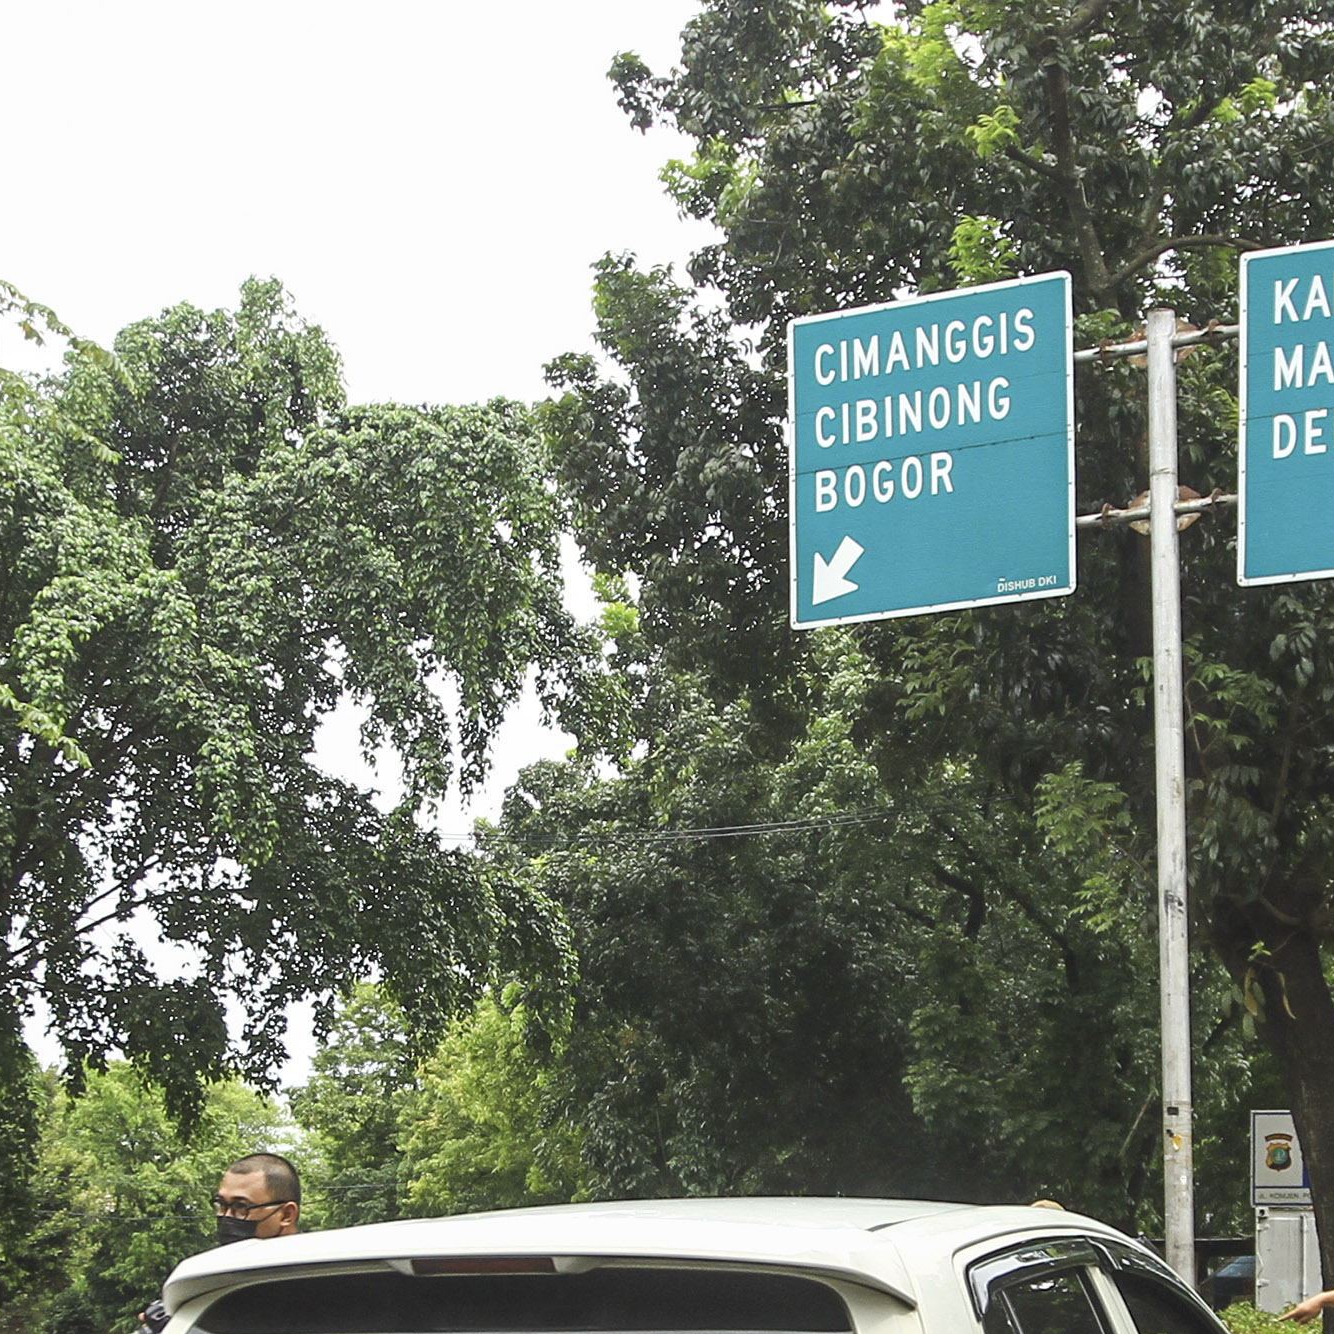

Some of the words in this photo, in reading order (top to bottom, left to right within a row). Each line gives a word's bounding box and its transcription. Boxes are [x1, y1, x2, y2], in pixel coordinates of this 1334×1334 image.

[814, 308, 1036, 387] CIMANGGIS
[814, 376, 1011, 448] CIBINONG
[815, 451, 954, 513] BOGOR
[997, 577, 1036, 593] DISHUB
[1038, 575, 1057, 587] DKI
